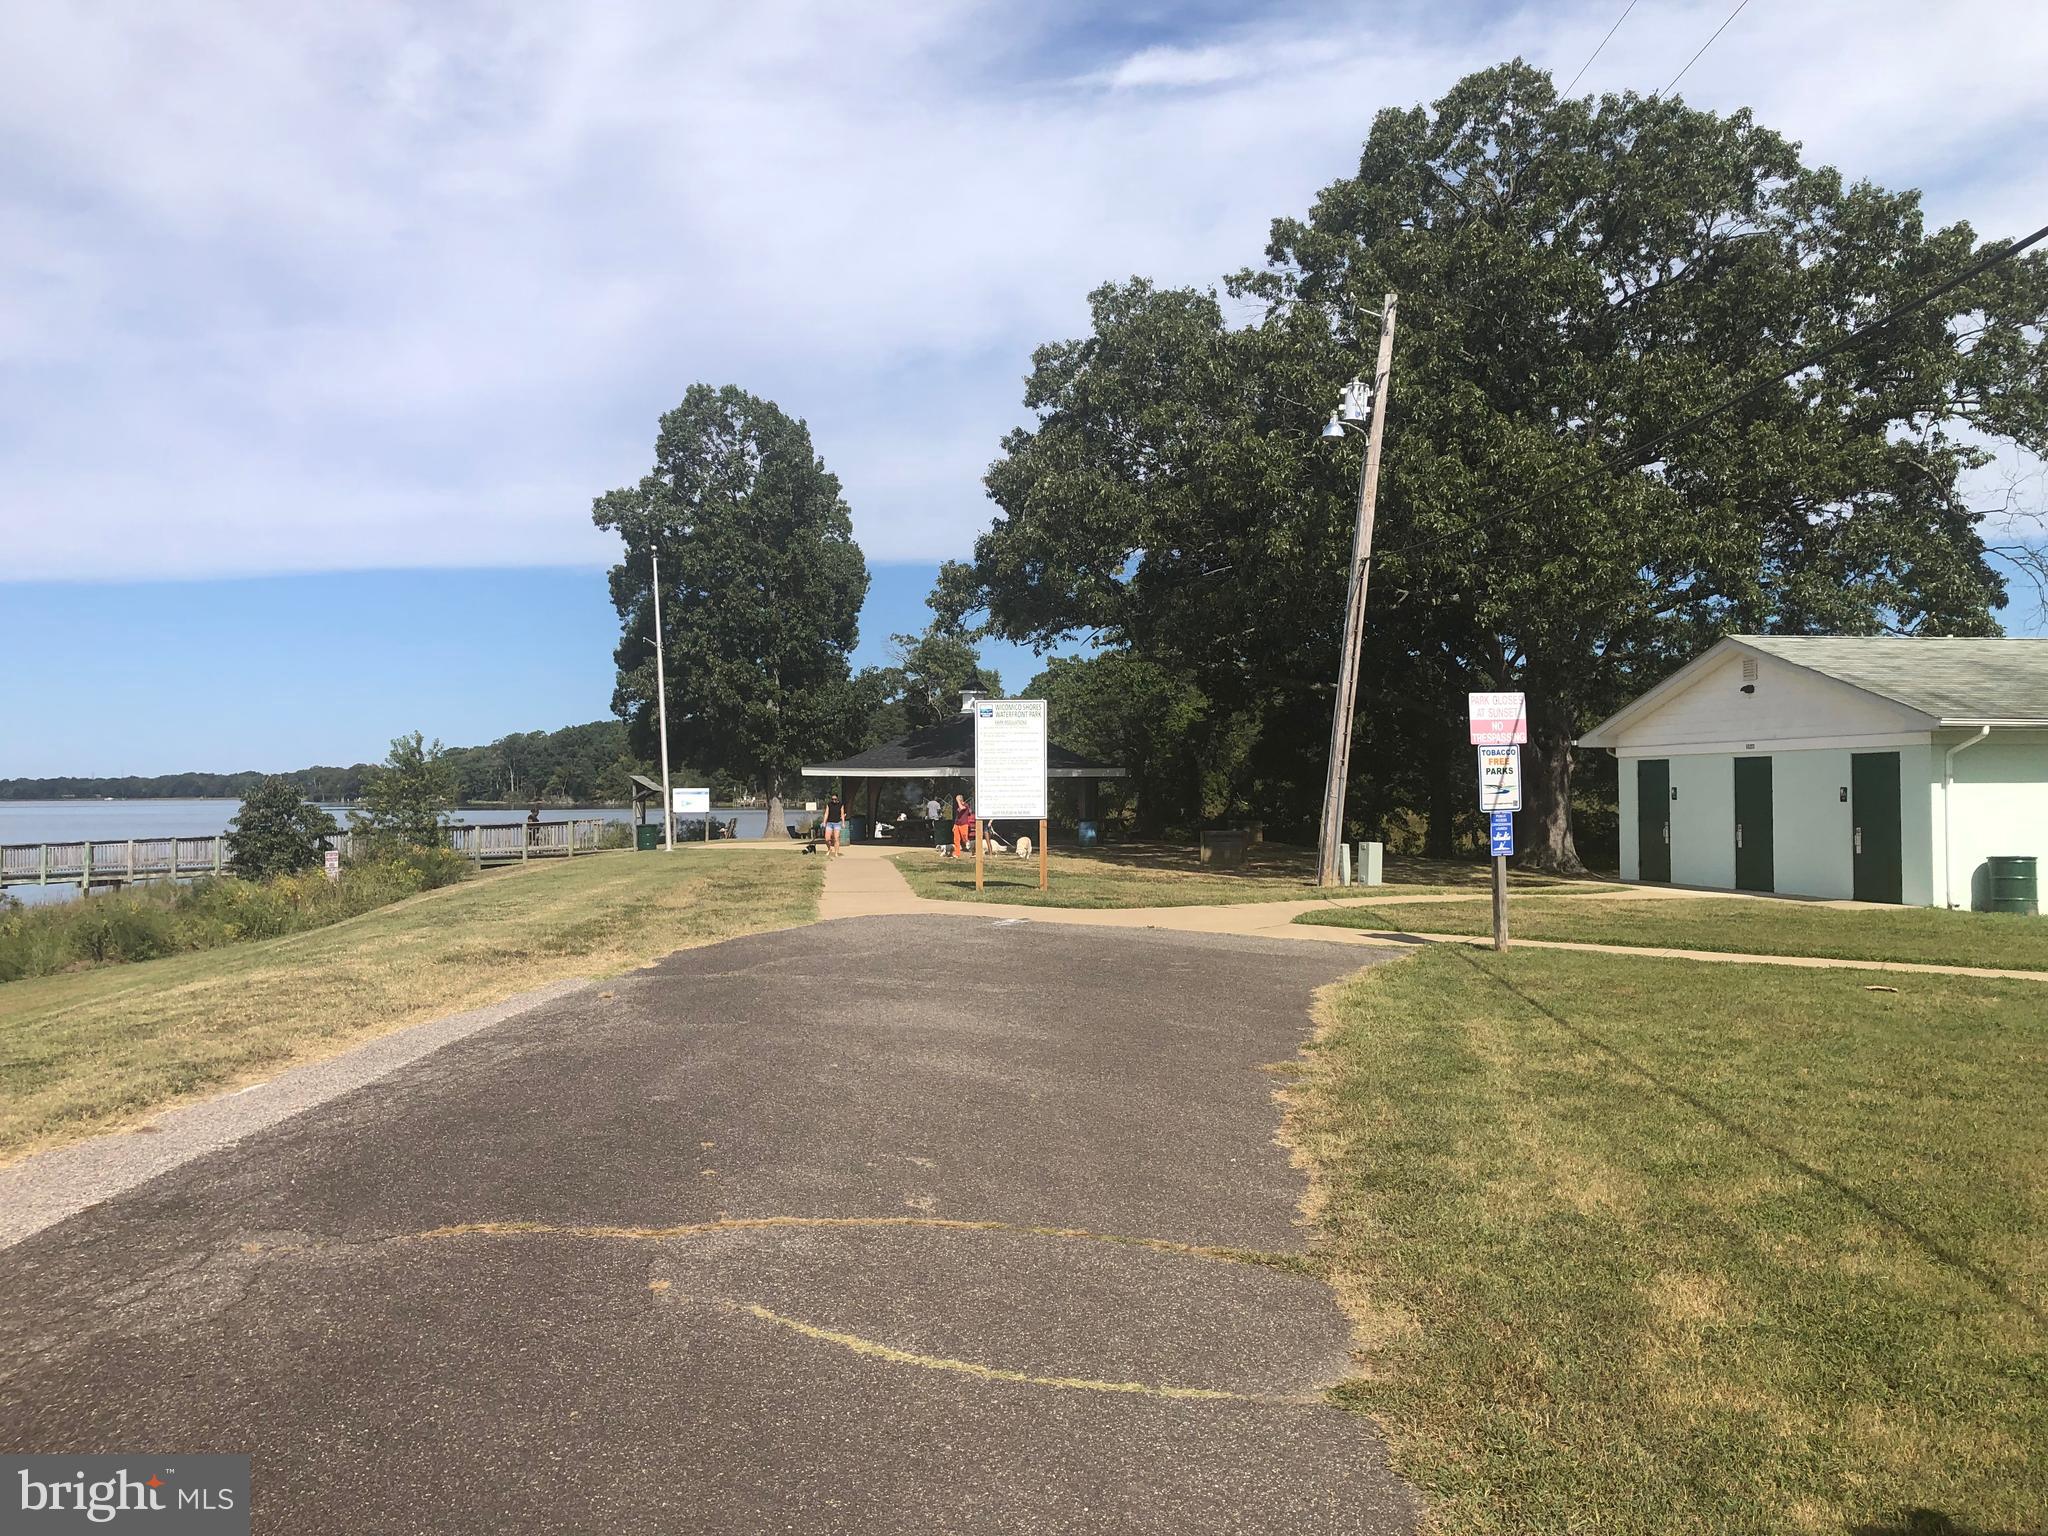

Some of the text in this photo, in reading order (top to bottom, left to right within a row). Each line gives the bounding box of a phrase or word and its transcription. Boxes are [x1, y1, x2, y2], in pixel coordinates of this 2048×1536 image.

[1471, 695, 1489, 705] PARK
[1477, 707, 1518, 717] AT SUNSET
[1491, 721, 1504, 731] NO
[1472, 733, 1525, 743] TRESPASSING
[1488, 757, 1510, 766] FREE
[1486, 767, 1514, 775] PARKS
